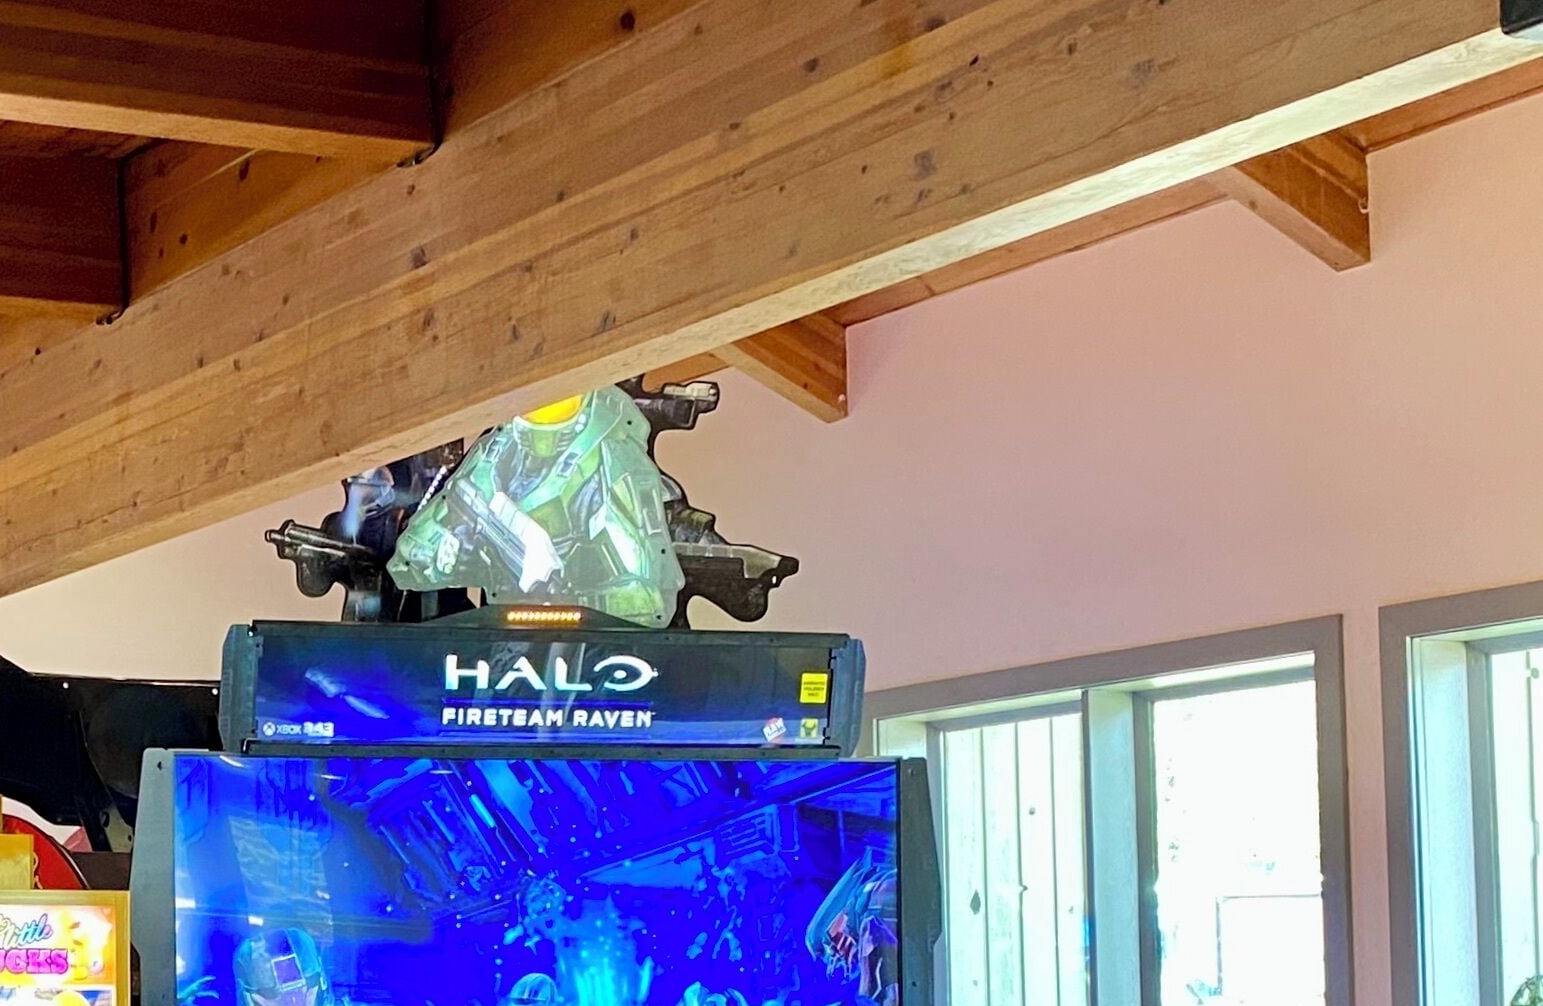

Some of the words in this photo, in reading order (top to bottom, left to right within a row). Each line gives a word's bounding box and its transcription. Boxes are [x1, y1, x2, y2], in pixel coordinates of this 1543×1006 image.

[445, 653, 659, 692] HALO
[442, 707, 563, 727] FIRETEAM
[572, 708, 653, 729] RAVEN
